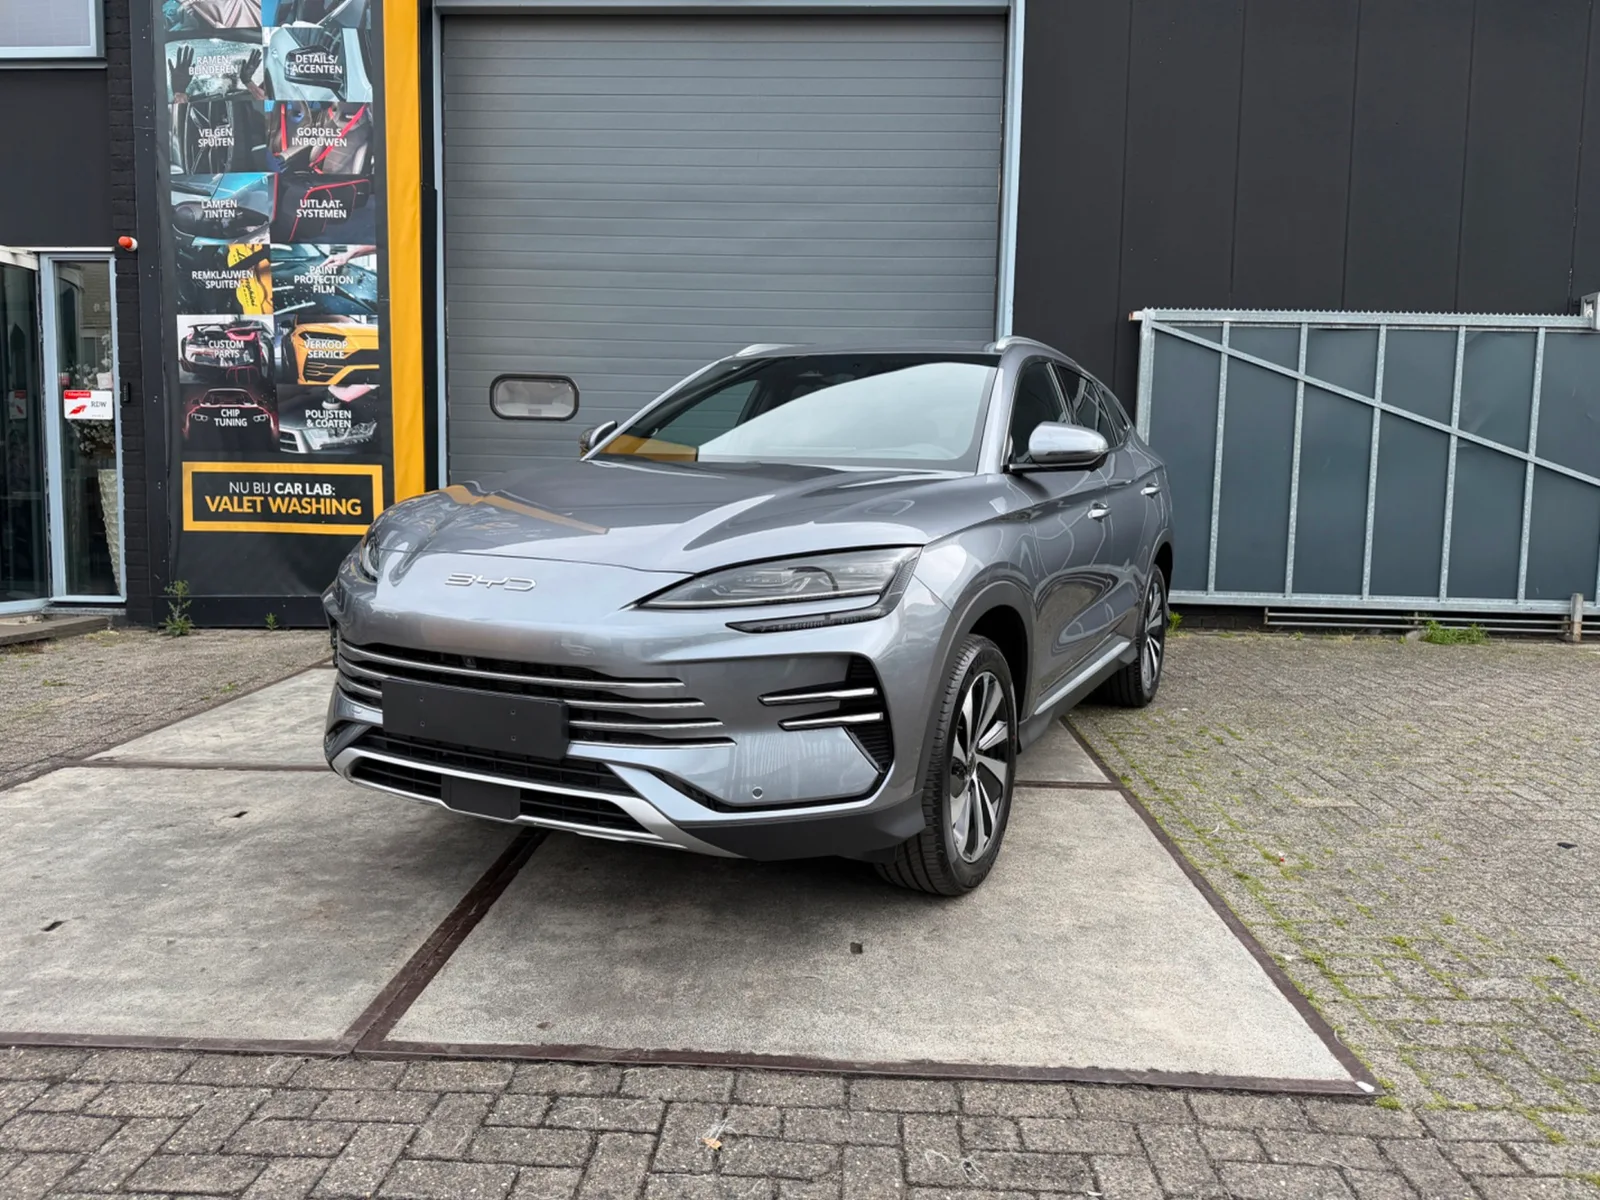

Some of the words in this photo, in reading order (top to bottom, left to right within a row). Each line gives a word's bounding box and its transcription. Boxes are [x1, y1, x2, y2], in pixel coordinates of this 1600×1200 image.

[295, 54, 338, 65] DETAILS/
[188, 64, 238, 75] BLINDEREN
[291, 64, 343, 75] ACCENTEN
[199, 127, 233, 137] VELGEN
[297, 127, 342, 137] GORDELS
[198, 136, 235, 147] SPUITEN
[291, 137, 348, 147] INBOUWEN
[201, 199, 237, 209] LAMPEN
[299, 199, 343, 209] UITLAAT-
[204, 209, 236, 218] TINTEN
[296, 208, 347, 219] SYSTEMEN
[191, 270, 254, 280] REMKLAUWEN
[309, 265, 338, 275] PAINT
[205, 279, 242, 289] SPUITEN
[293, 275, 354, 284] PROTECTION
[312, 284, 336, 294] FILM
[208, 339, 244, 349] CUSTOM
[303, 339, 348, 349] VERKOOP
[214, 349, 240, 359] PARTS
[307, 349, 345, 359] SERVICE
[220, 408, 240, 418] CHIP
[305, 409, 352, 420] POLIJSTEN
[214, 417, 248, 427] TUNING
[306, 419, 314, 428] &
[315, 419, 352, 429] COATEN
[228, 481, 250, 494] NU
[252, 481, 271, 495] BIJ
[274, 482, 303, 495] CAR
[305, 483, 336, 496] LAB:
[204, 495, 265, 513] VALET
[268, 496, 362, 516] WASHING
[444, 572, 537, 592] BYD
